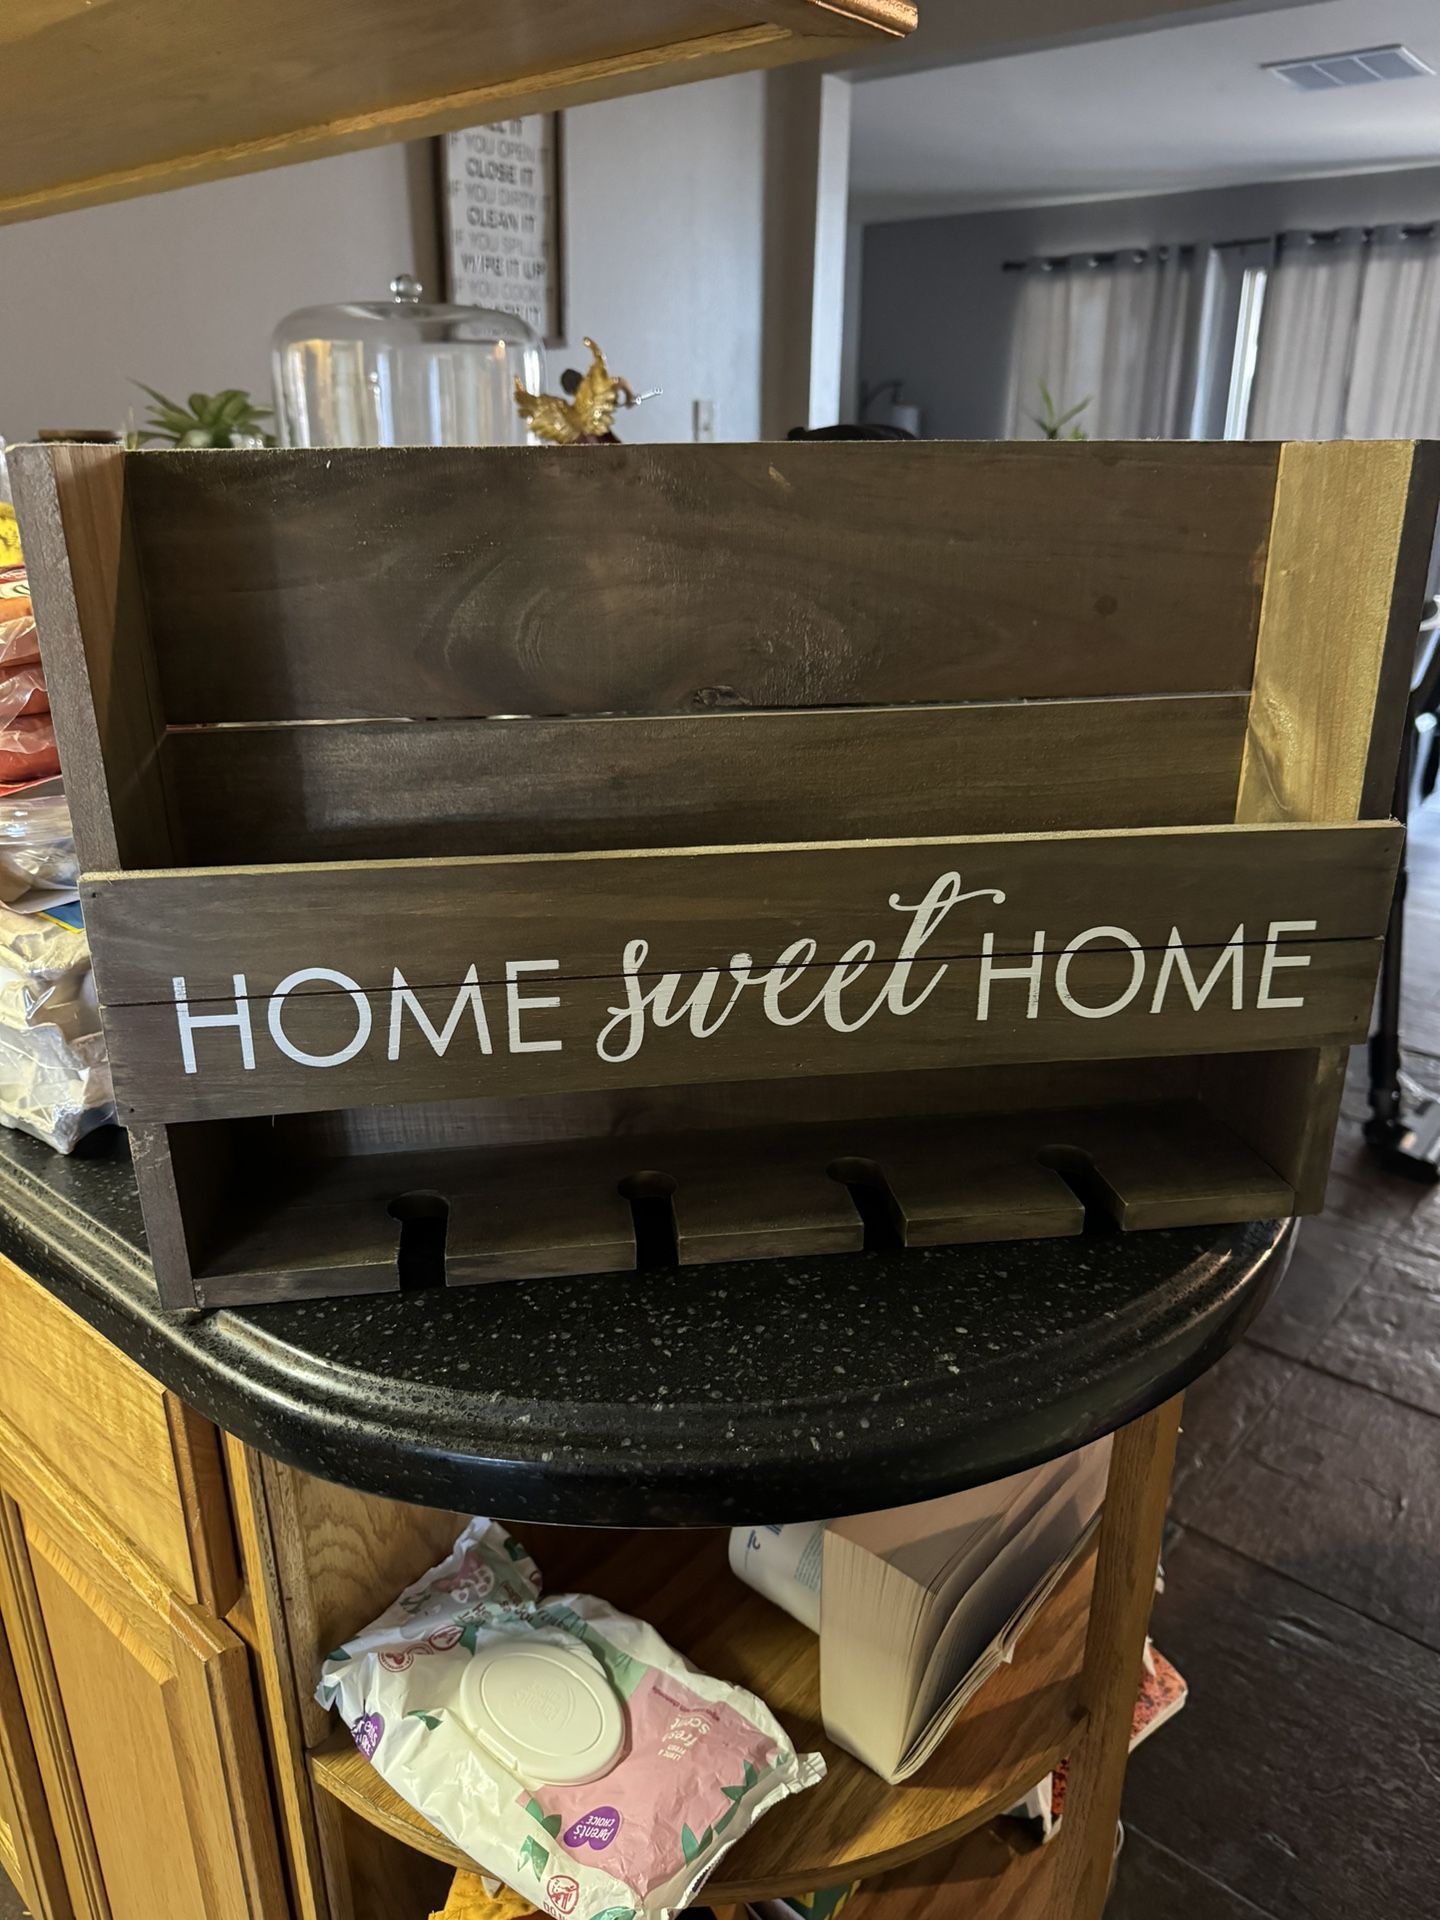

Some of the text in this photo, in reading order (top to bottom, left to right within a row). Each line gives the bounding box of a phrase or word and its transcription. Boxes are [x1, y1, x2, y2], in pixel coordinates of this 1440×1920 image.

[464, 133, 496, 156] YOU
[465, 157, 534, 188] CLOSE IT
[464, 182, 497, 205] YOU
[466, 205, 535, 233] CLEAN IT
[460, 252, 546, 281] WIPE IT UP
[173, 871, 1317, 1074] HOME sweet HOME
[573, 1824, 615, 1842] Parent's
[585, 1815, 616, 1827] CHOICE
